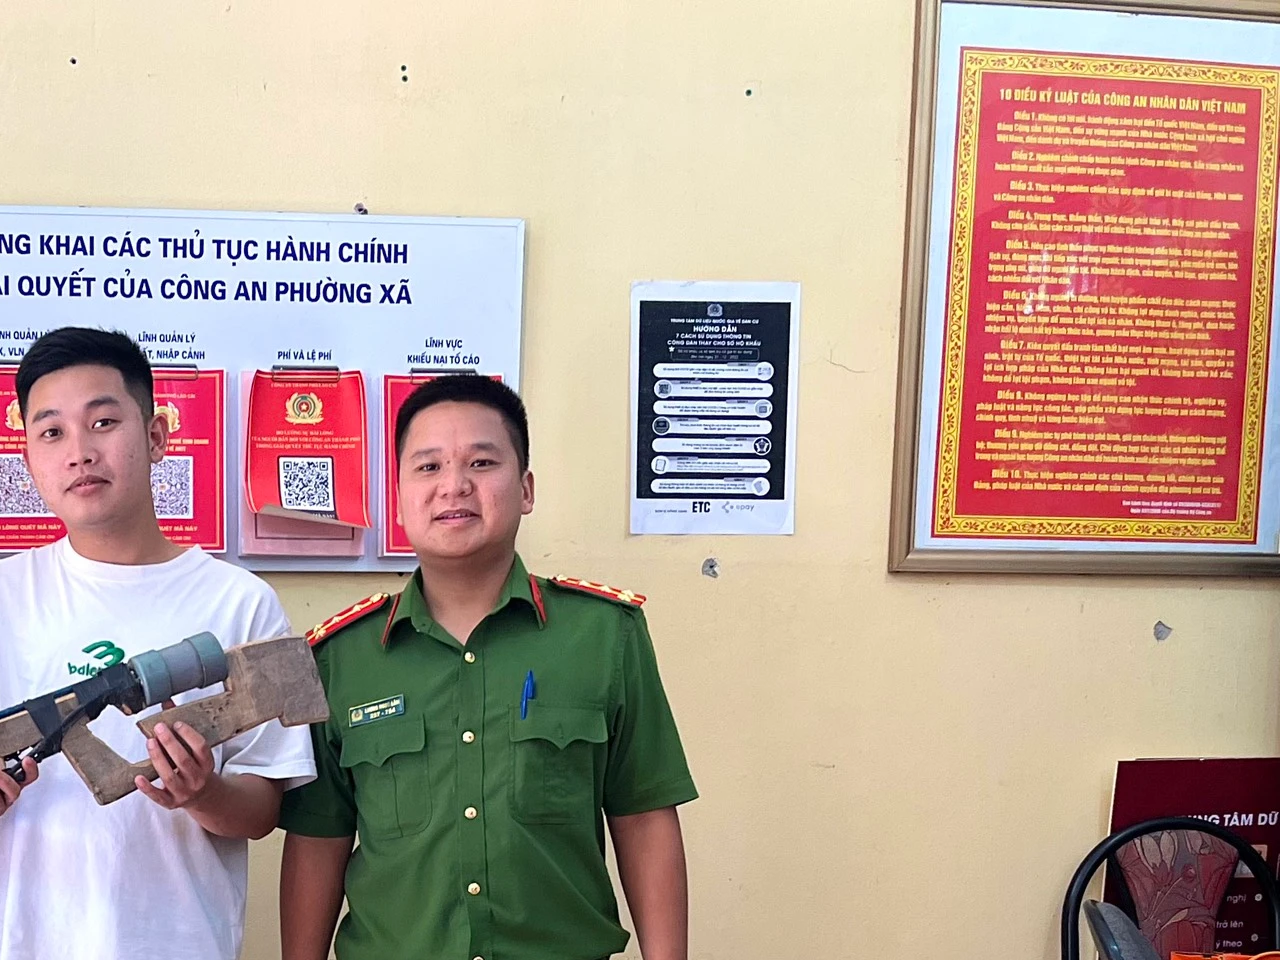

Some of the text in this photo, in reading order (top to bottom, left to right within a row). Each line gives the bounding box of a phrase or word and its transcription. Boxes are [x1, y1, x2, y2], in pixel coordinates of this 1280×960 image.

[1000, 88, 1012, 100] 10
[1013, 87, 1036, 101] ĐIỀU
[1054, 89, 1079, 105] LUẬT
[1080, 90, 1101, 105] CỦA
[1103, 91, 1130, 106] CÔNG
[1132, 95, 1147, 107] AN
[1149, 94, 1176, 109] NHÂN
[1178, 96, 1199, 111] DÂN
[1201, 97, 1223, 114] VIỆT
[1223, 101, 1246, 114] NAM
[39, 234, 95, 256] KHAI
[102, 231, 151, 257] CÁC
[159, 229, 205, 259] THỦ
[212, 239, 259, 267] TỤC
[266, 236, 331, 263] HÀNH
[338, 237, 408, 264] CHÍNH
[17, 268, 96, 297] QUYẾT
[103, 268, 153, 299] CỦA
[160, 273, 227, 300] CÔNG
[234, 280, 267, 301] AN
[275, 276, 372, 303] PHƯỜNG
[379, 278, 412, 305] XÃ
[13, 327, 38, 340] QUẢN
[138, 330, 196, 343] LĨNH QUẢN LÝ
[425, 336, 463, 351] LĨNH VỰC
[156, 347, 180, 362] NHẬP
[181, 346, 205, 360] CẢNH
[277, 348, 332, 363] PHÍ VÀ LỆ PHÍ
[407, 350, 480, 367] KHIẾU NẠI TỐ CÁO
[691, 501, 711, 513] ETC
[1223, 811, 1253, 827] TÂM
[1257, 811, 1280, 826] DỮ
[1226, 894, 1247, 904] nghị
[1229, 919, 1244, 929] lên
